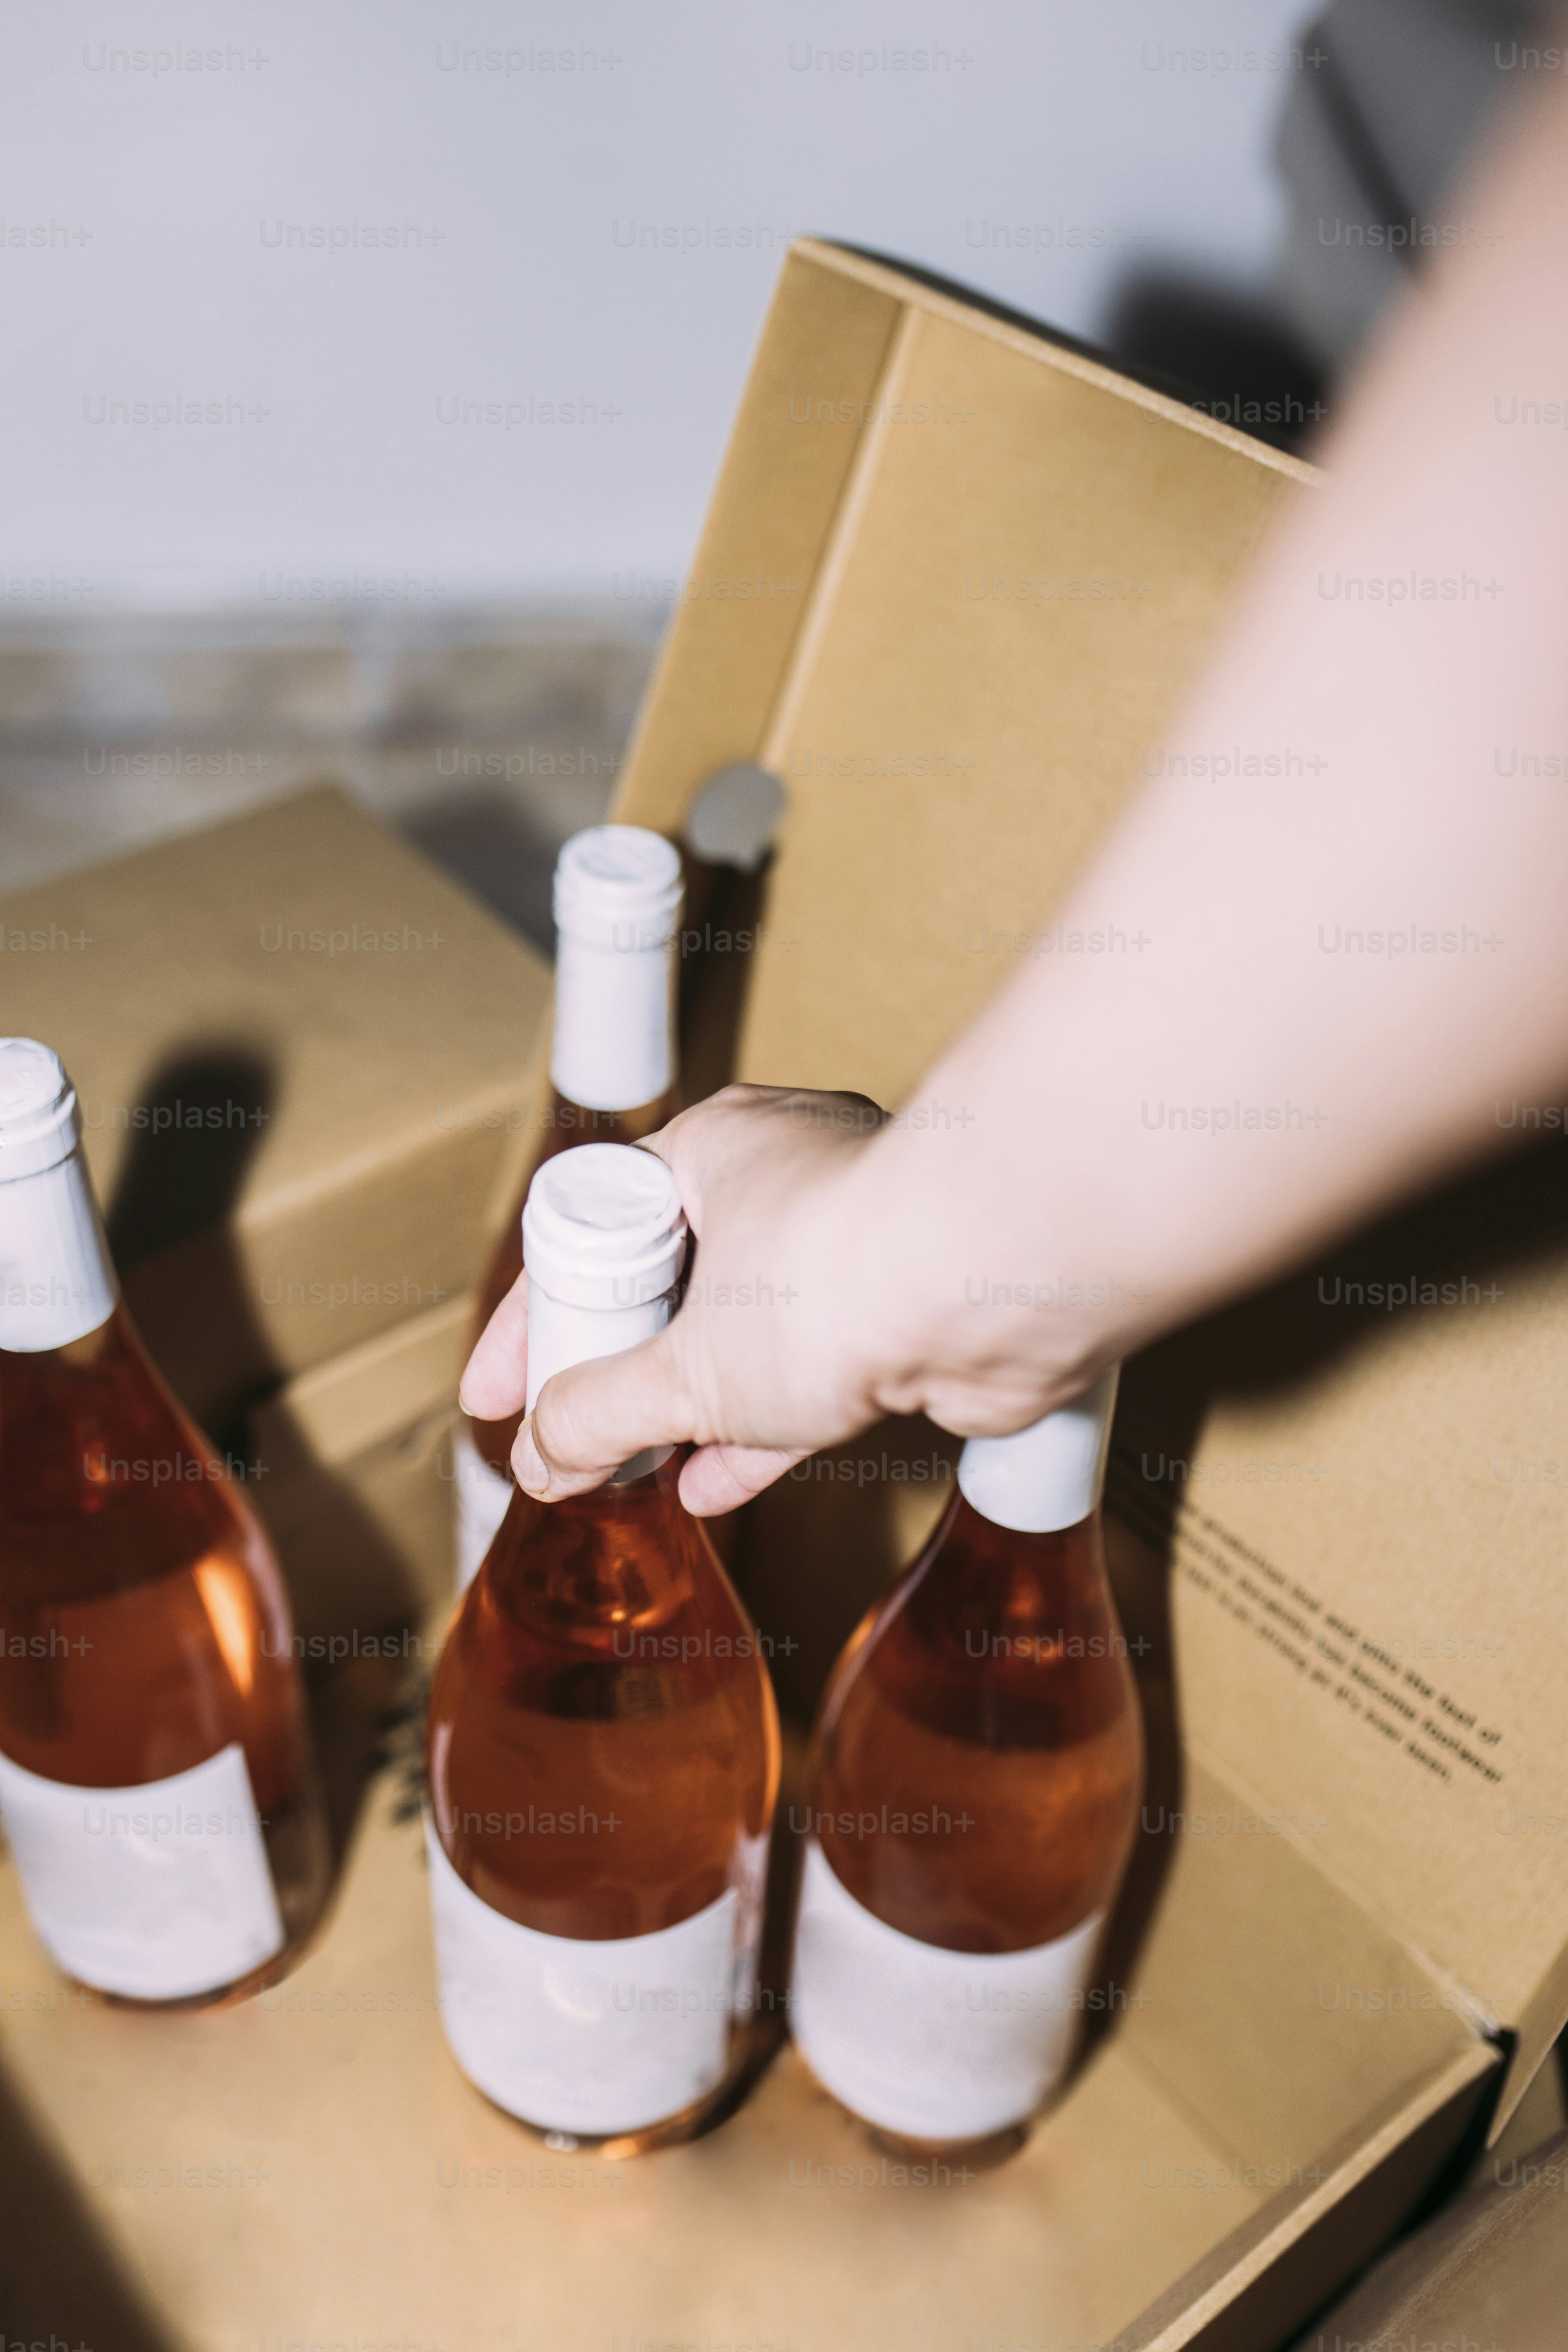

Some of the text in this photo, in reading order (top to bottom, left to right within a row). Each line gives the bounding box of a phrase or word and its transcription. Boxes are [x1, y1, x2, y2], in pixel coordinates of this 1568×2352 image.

[1198, 1515, 1290, 1590] production
[1325, 1610, 1358, 1640] and
[1360, 1637, 1402, 1673] onto
[1402, 1668, 1437, 1700] the
[1435, 1693, 1478, 1731] feet
[1475, 1723, 1503, 1750] of
[1334, 1682, 1365, 1712] it's
[1363, 1707, 1405, 1744] ever
[1349, 1662, 1420, 1723] become
[1420, 1717, 1504, 1789] footwear
